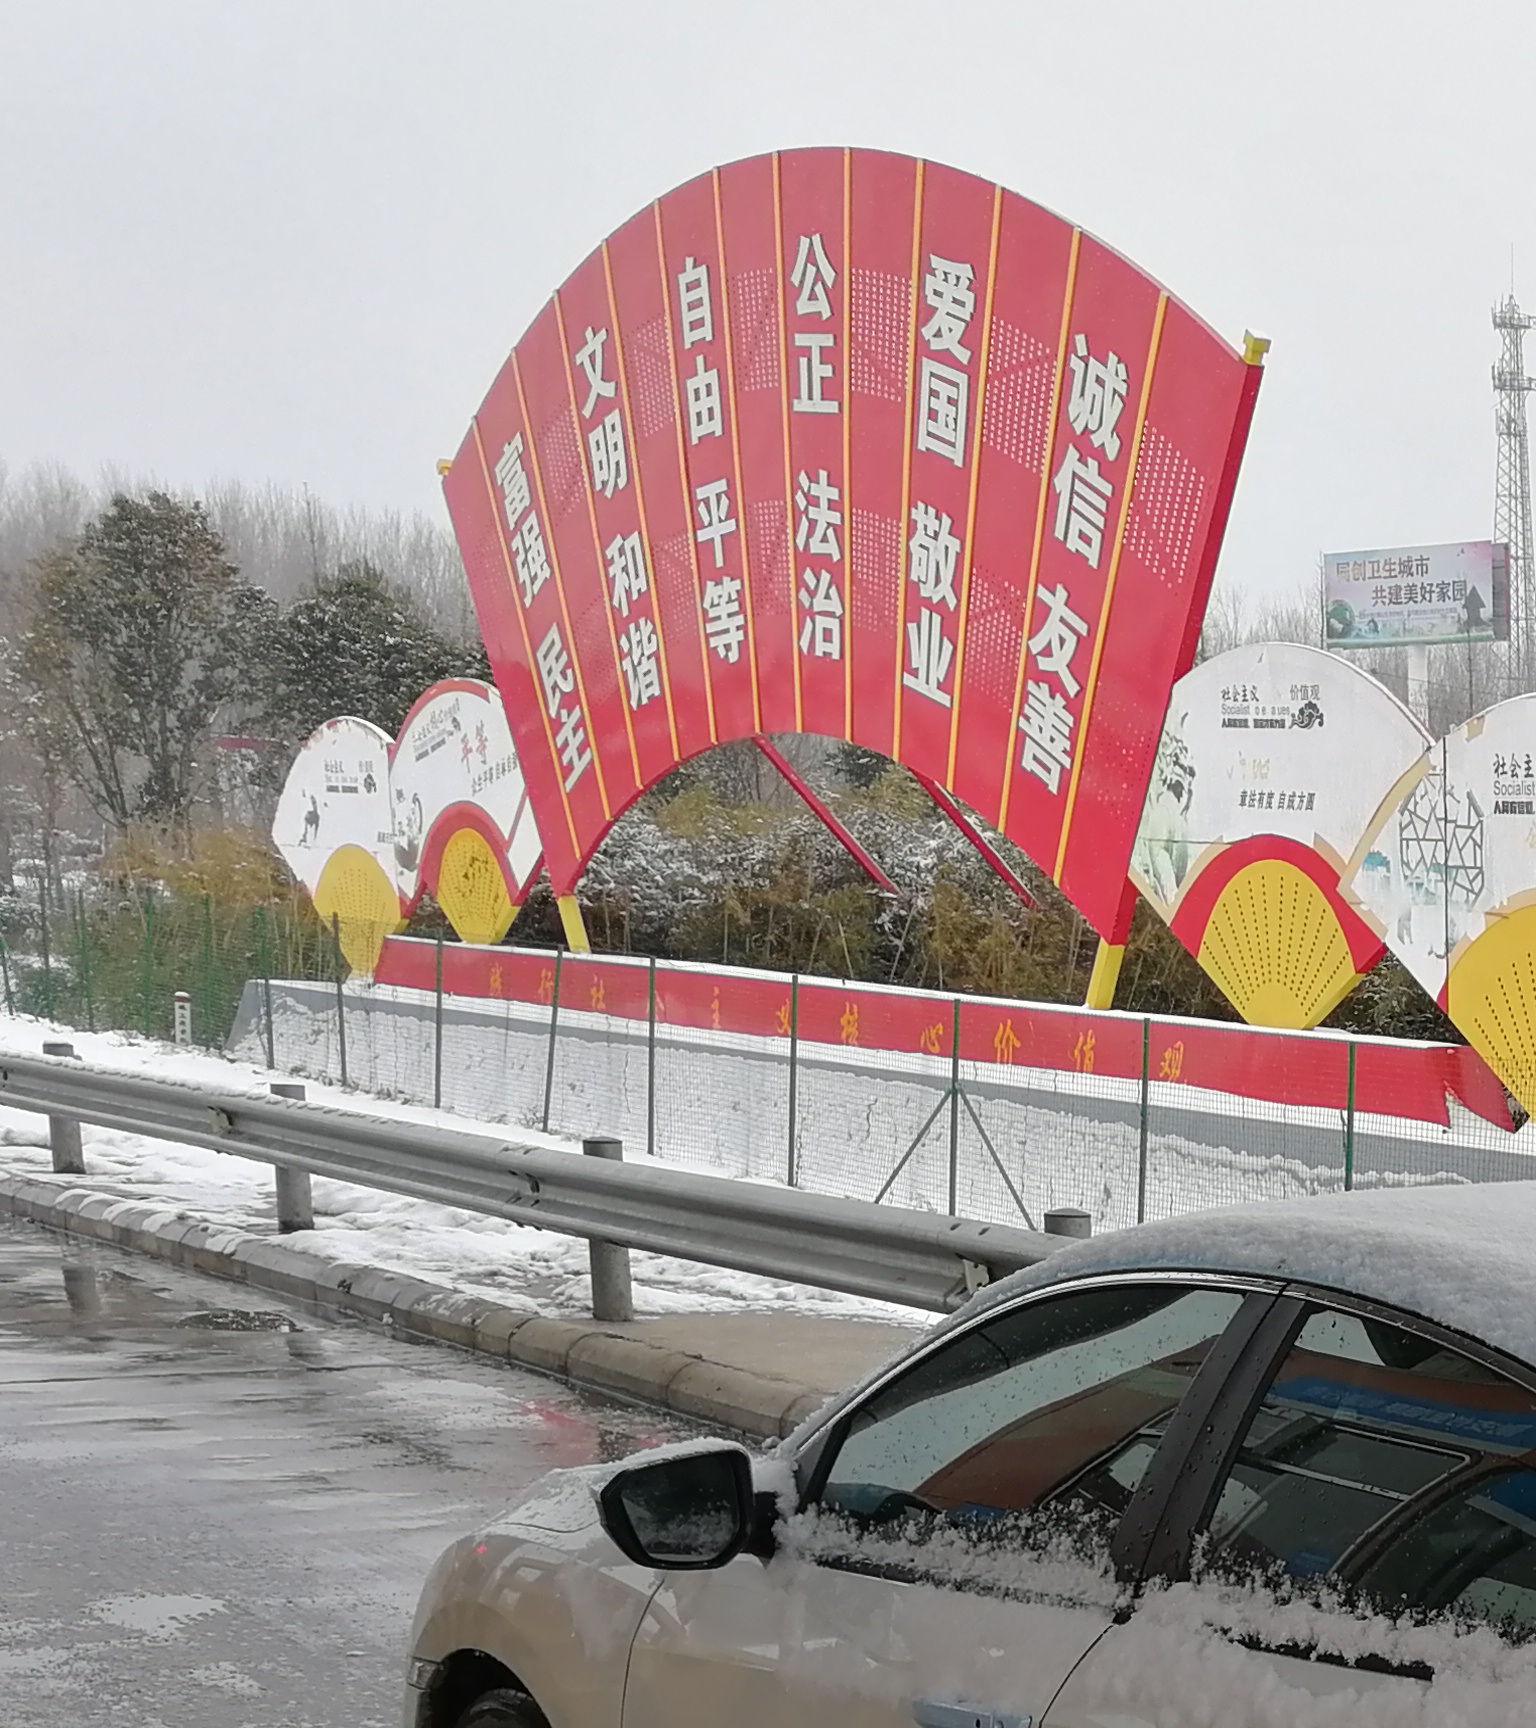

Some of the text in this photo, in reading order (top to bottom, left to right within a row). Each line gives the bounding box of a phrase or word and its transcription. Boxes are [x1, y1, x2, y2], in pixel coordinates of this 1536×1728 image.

[494, 431, 593, 794] 富强 民主
[575, 325, 662, 712] 文明 和谐
[677, 256, 747, 665] 自由 平等
[789, 232, 845, 661] 公正 法治
[903, 252, 977, 710] 爱国 敬业
[1018, 333, 1129, 796] 诚信 友善
[1371, 580, 1467, 608] 共建美好家园
[1220, 684, 1321, 702] 社会主义 价值观
[1493, 779, 1535, 796] Socialist
